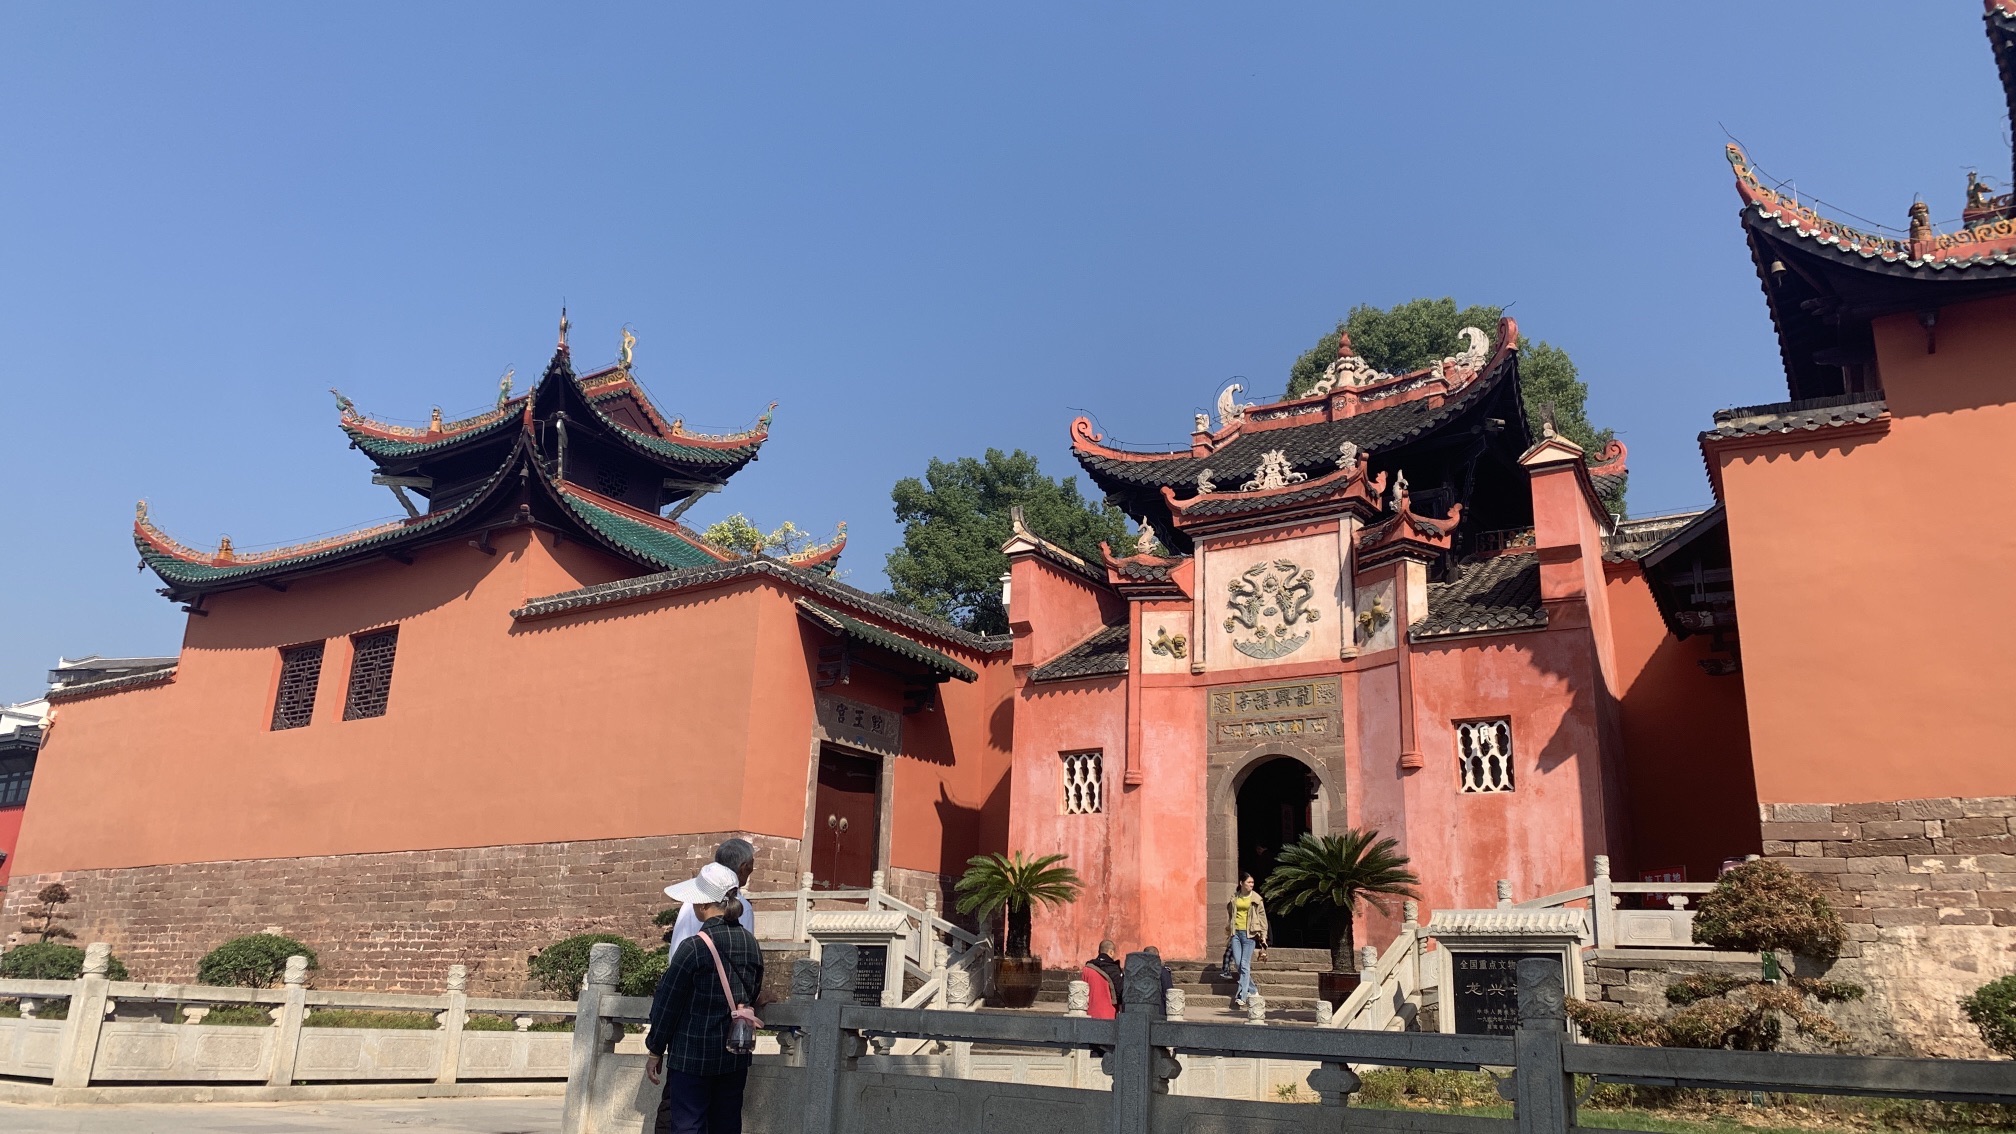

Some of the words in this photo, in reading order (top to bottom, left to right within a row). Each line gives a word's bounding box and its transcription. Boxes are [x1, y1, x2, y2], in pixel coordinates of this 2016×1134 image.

[1459, 959, 1517, 970] 全国重点文物
[1464, 982, 1518, 996] 龙兴
